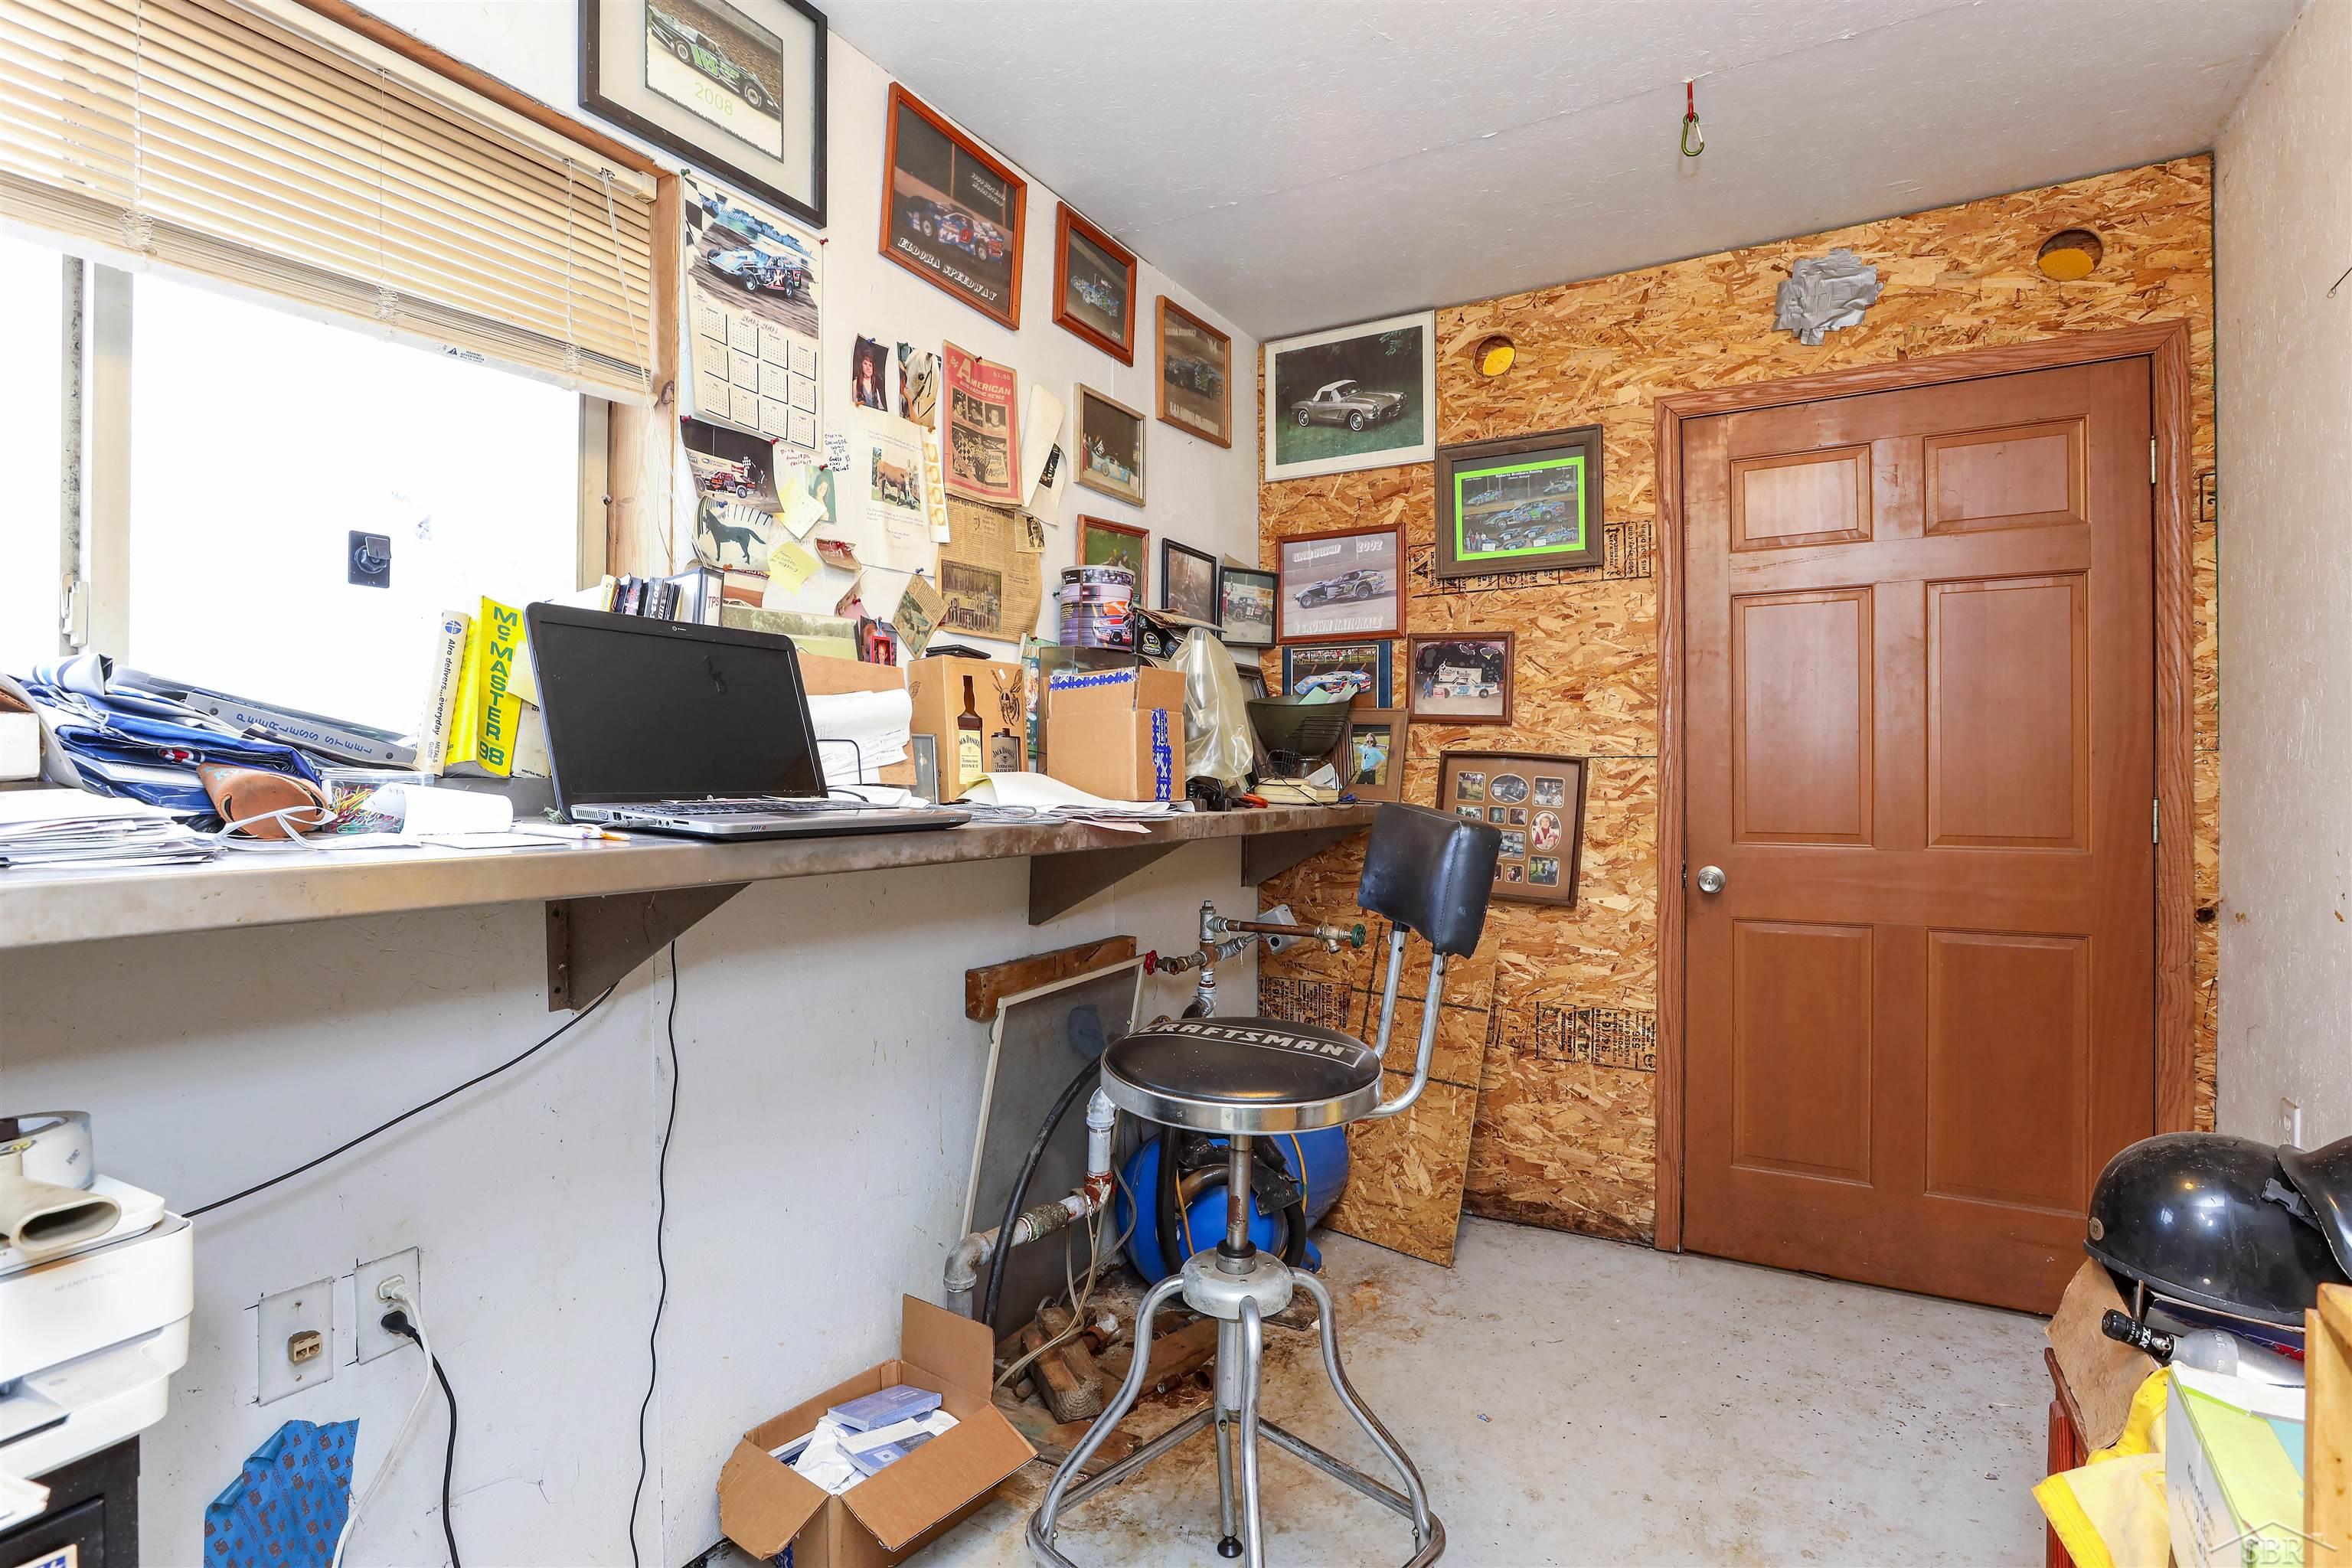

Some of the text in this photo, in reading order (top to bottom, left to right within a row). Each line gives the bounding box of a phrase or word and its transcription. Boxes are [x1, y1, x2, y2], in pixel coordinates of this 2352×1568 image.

[694, 81, 733, 116] 2008
[897, 237, 998, 301] ELDORA SPEEDWAY
[957, 358, 1011, 396] AMERICAN
[959, 381, 1004, 401] AUTO RACING NEWS
[1357, 540, 1383, 552] 2002
[708, 596, 720, 609] TPS
[444, 639, 456, 655] Alro
[236, 713, 373, 754] PEERLESS STEEL
[479, 740, 505, 766] 98
[1139, 1021, 1345, 1057] CRAFTSMAN
[1632, 1031, 1641, 1049] 536
[54, 1284, 66, 1292] HP
[67, 1277, 89, 1288] ENVY
